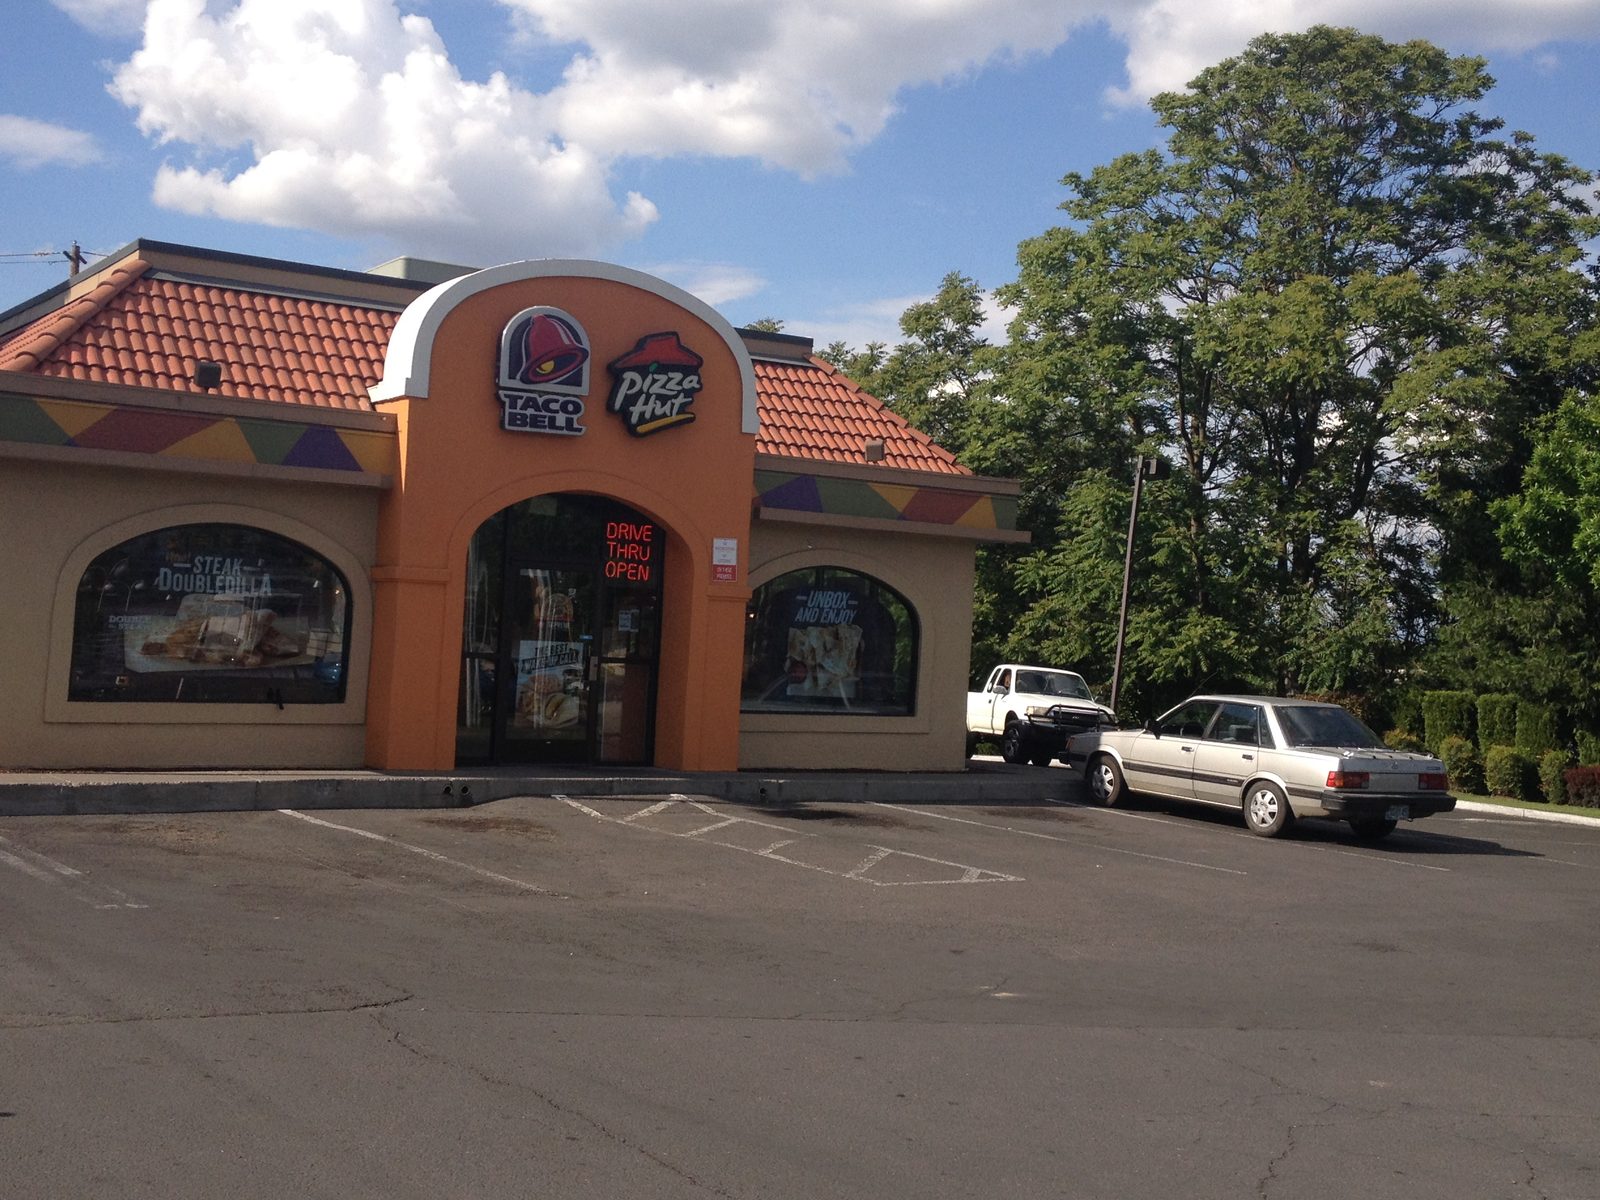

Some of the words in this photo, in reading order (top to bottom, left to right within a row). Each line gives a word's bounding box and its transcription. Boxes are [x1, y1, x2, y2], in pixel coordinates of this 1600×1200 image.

[504, 394, 582, 415] TACO
[630, 393, 693, 424] Hut
[508, 412, 583, 432] BELL
[606, 522, 653, 541] DRIVE
[606, 541, 650, 561] THRU
[193, 555, 244, 577] STEAK
[605, 561, 649, 581] OPEN
[807, 590, 850, 609] UNBOX
[795, 607, 819, 622] AND
[820, 608, 857, 624] ENJOY
